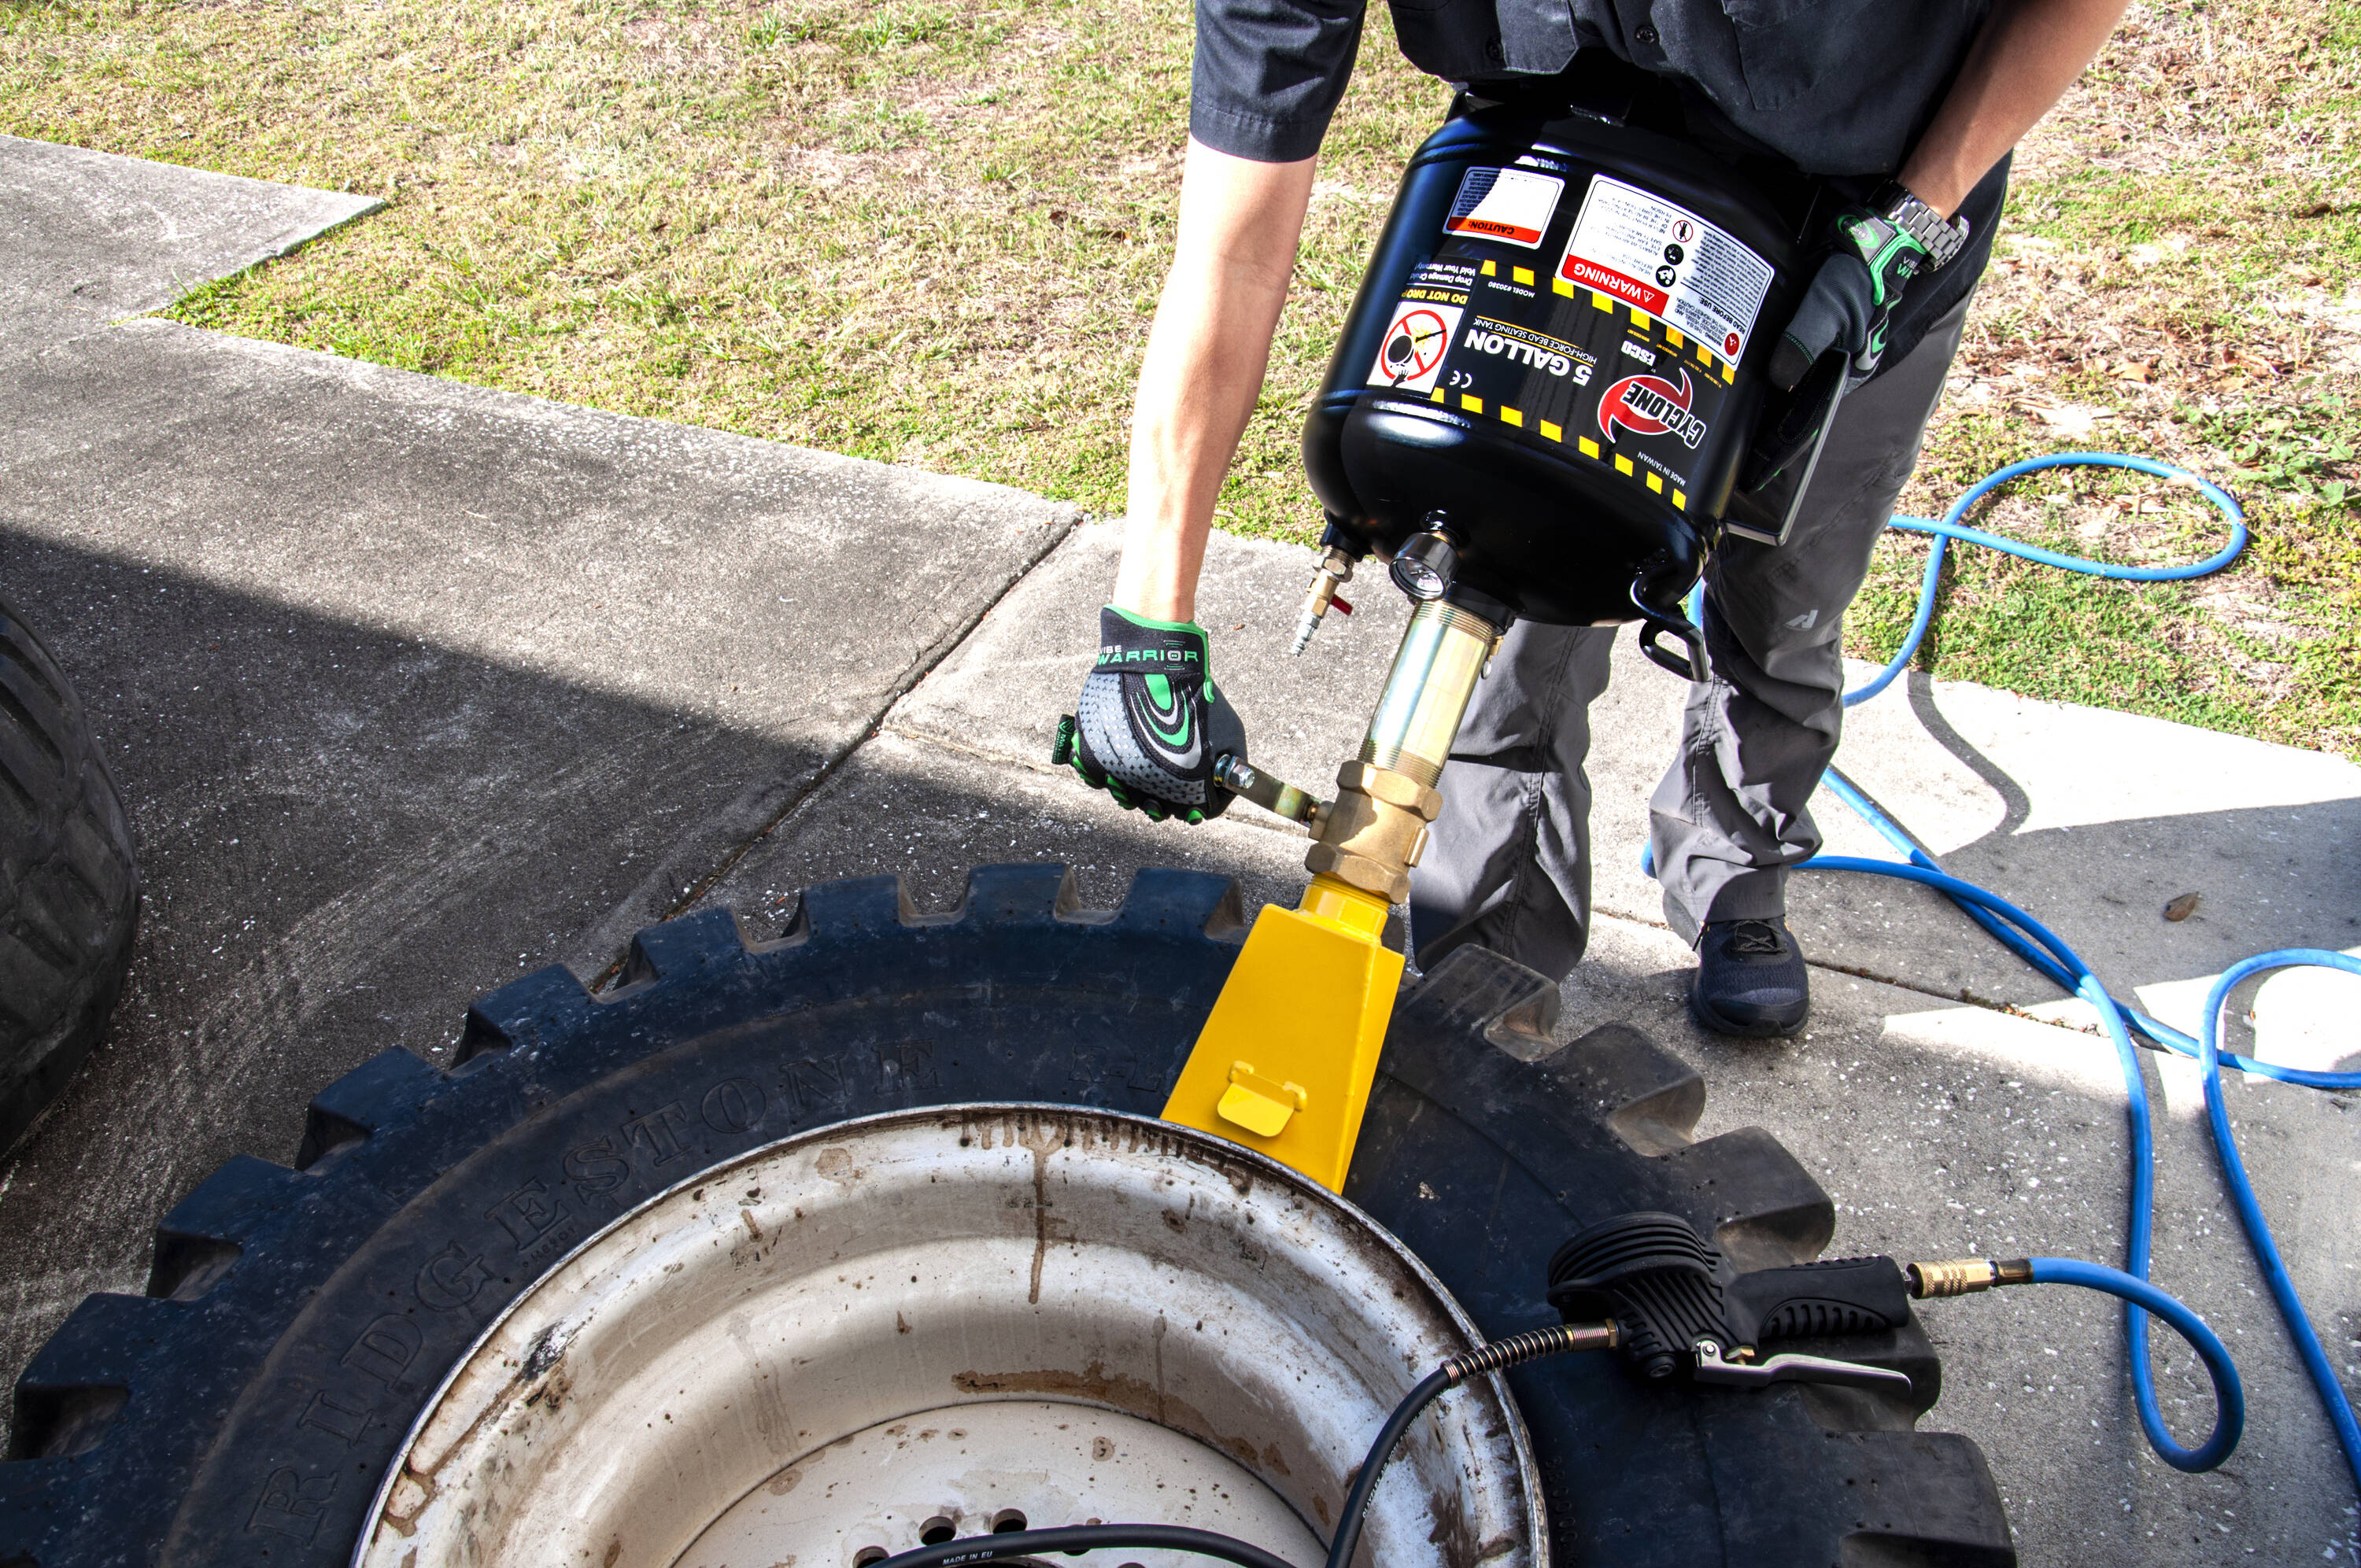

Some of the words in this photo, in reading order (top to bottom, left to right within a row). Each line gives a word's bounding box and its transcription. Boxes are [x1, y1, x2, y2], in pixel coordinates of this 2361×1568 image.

[1467, 220, 1514, 234] CAUTION:
[1443, 264, 1458, 274] Your
[1459, 266, 1476, 277] Void
[1427, 271, 1454, 283] Damage
[1454, 275, 1472, 286] Drop
[1572, 262, 1640, 299] WARNING
[1487, 280, 1512, 293] #20380
[1511, 286, 1535, 298] MODEL
[1426, 290, 1450, 301] NOT
[1450, 293, 1468, 304] DO
[1711, 304, 1734, 323] BEFORE
[1472, 317, 1493, 329] TANK
[1731, 320, 1746, 334] READ
[1493, 323, 1527, 339] SEATING
[1527, 332, 1549, 346] BEAD
[1463, 327, 1568, 376] GALLON
[1548, 339, 1597, 363] HIGH-FORCE
[1620, 339, 1656, 366] ESCO
[1572, 363, 1593, 386] 5
[1619, 380, 1706, 448] CYCLONE
[1636, 450, 1663, 471] TAIWAN
[1662, 465, 1671, 475] IN
[1669, 470, 1686, 486] MADE
[1098, 651, 1198, 665] WARRIOR
[943, 1555, 966, 1566] MADE
